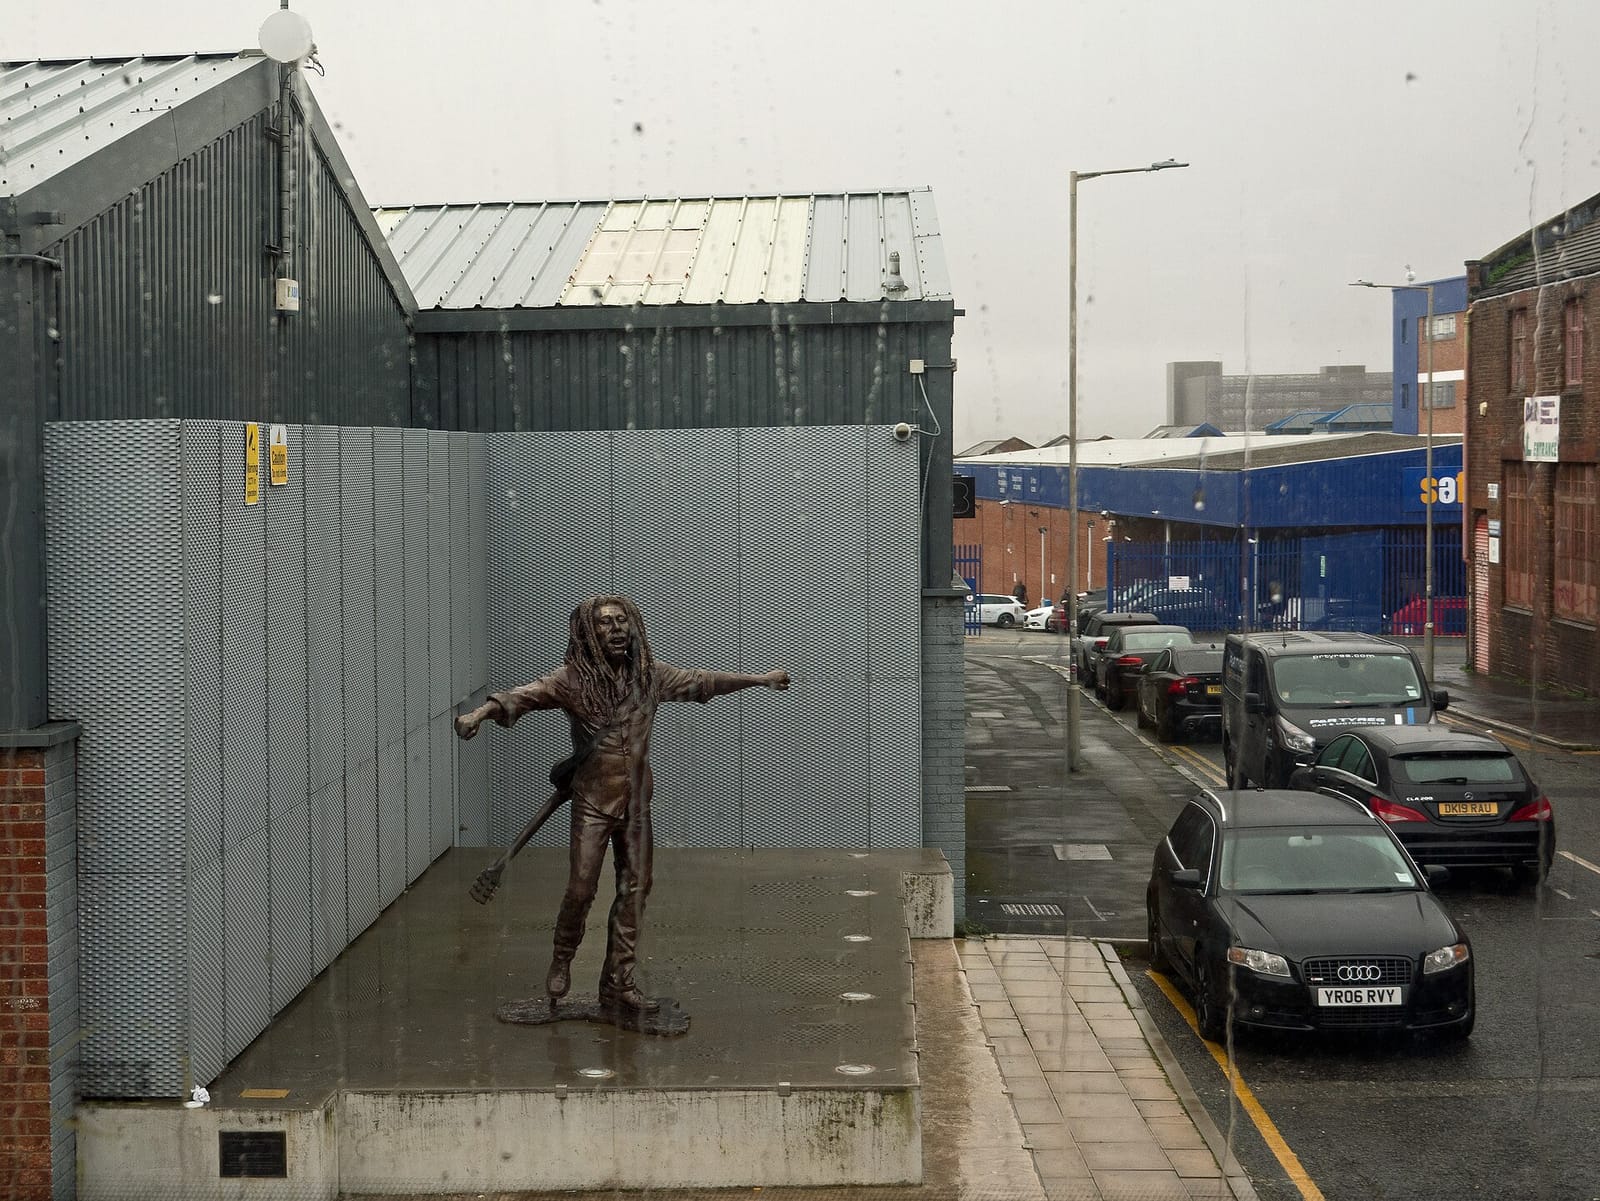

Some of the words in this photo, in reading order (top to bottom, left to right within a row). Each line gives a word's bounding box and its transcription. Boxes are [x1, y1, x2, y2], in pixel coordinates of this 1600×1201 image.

[1533, 442, 1557, 457] ENTRANCE
[1445, 804, 1468, 813] DK19
[1472, 804, 1491, 812] RAU
[1325, 990, 1363, 1003] YR06
[1368, 990, 1394, 1002] RVY
